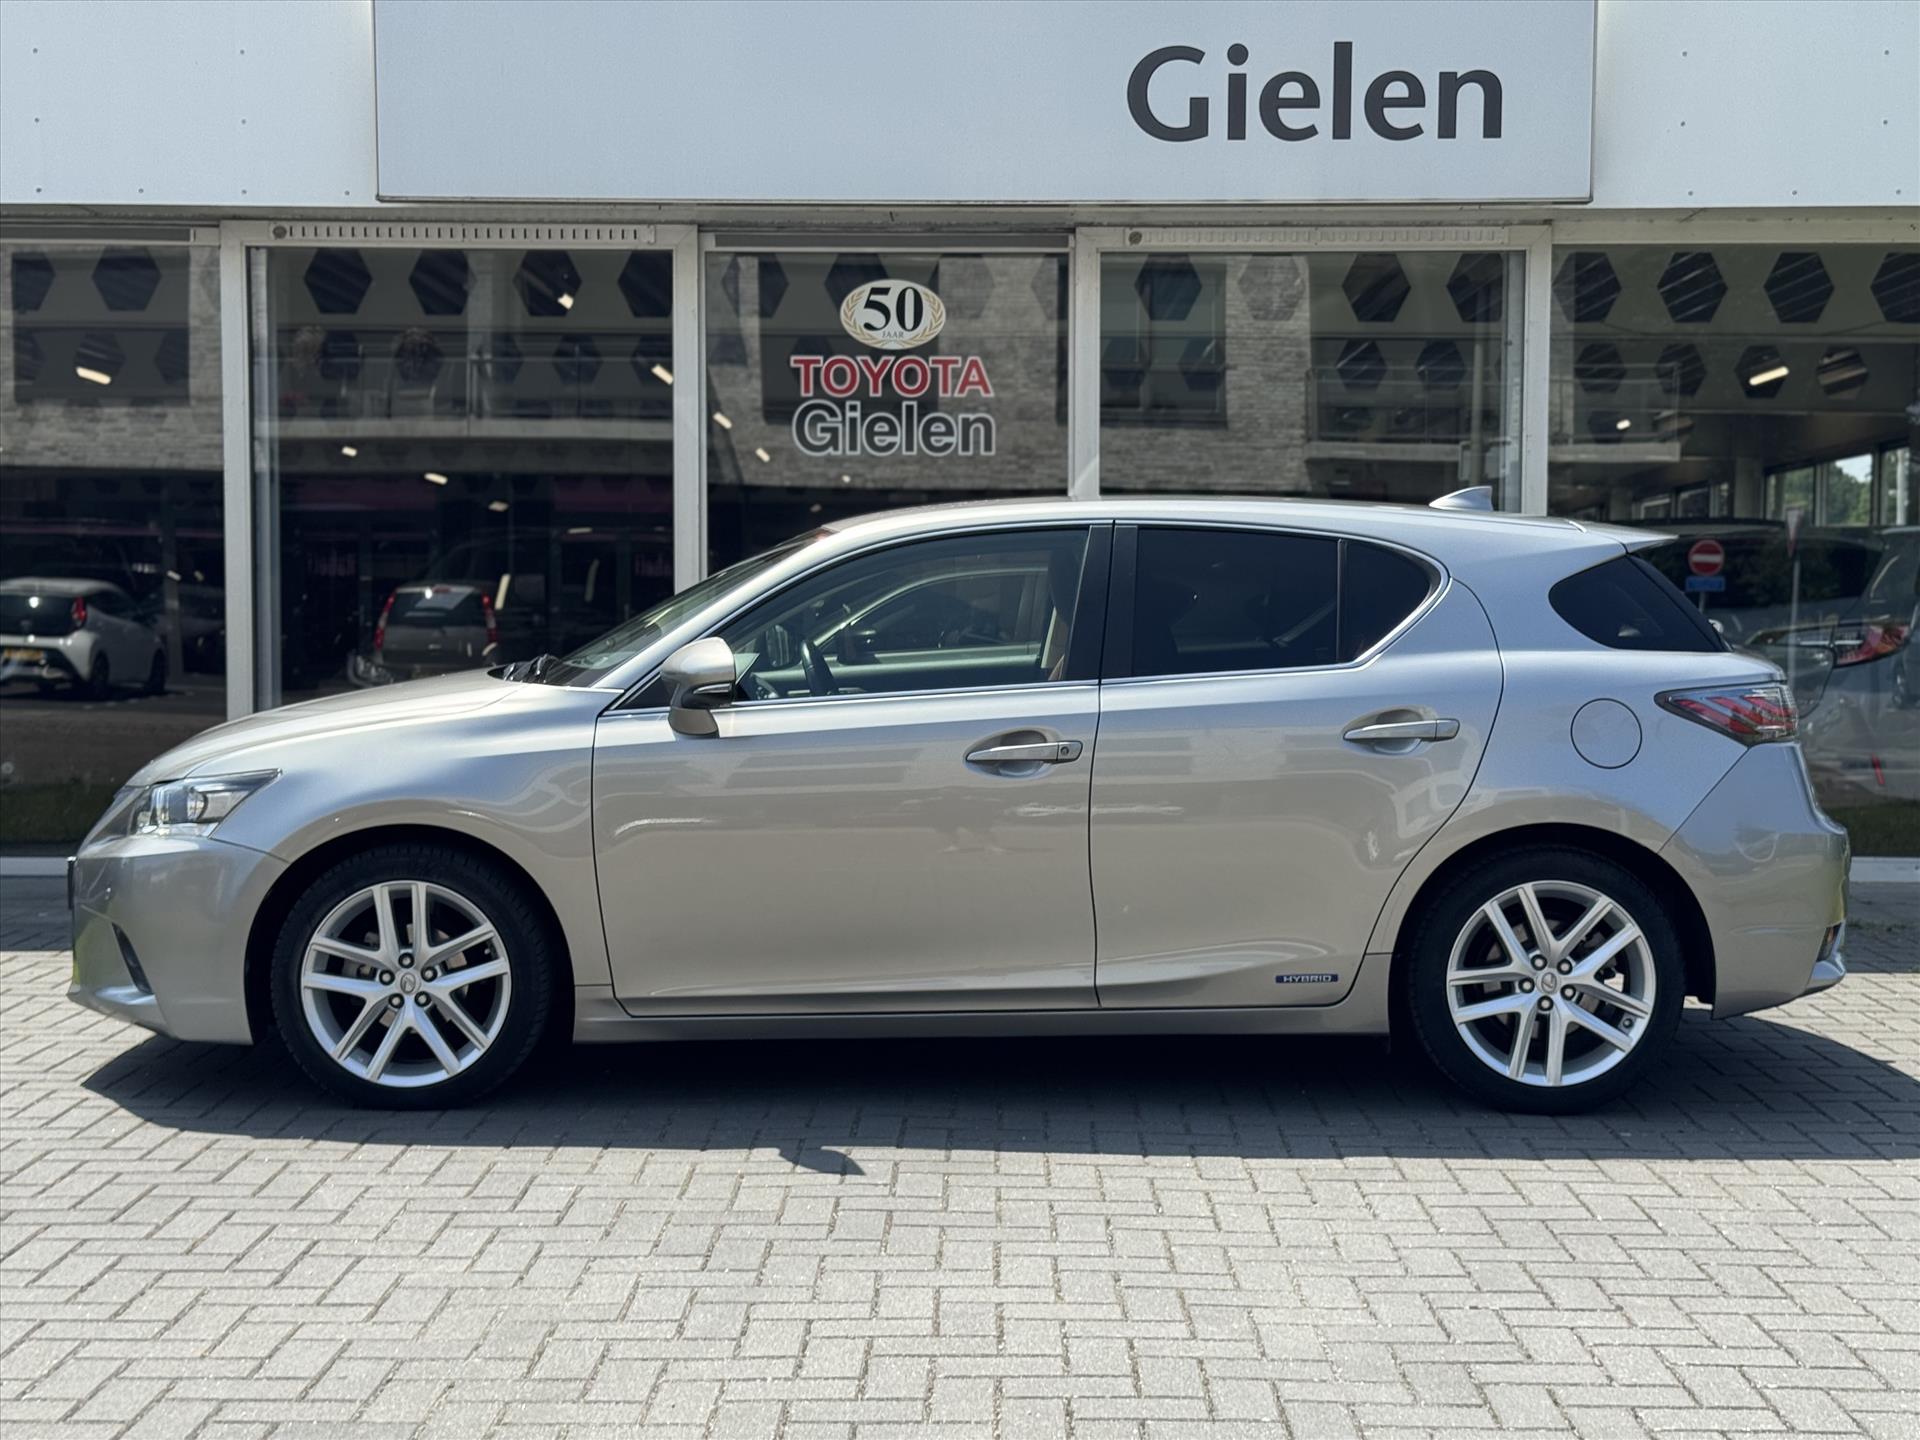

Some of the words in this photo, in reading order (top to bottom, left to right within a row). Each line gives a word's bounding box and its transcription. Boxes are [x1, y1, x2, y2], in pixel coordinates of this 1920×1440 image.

[1127, 41, 1502, 142] Gielen
[863, 286, 924, 332] 50
[881, 330, 905, 339] JAAR
[790, 355, 994, 397] TOYOTA
[792, 400, 996, 456] Gielen
[1282, 974, 1333, 983] HYBRID
